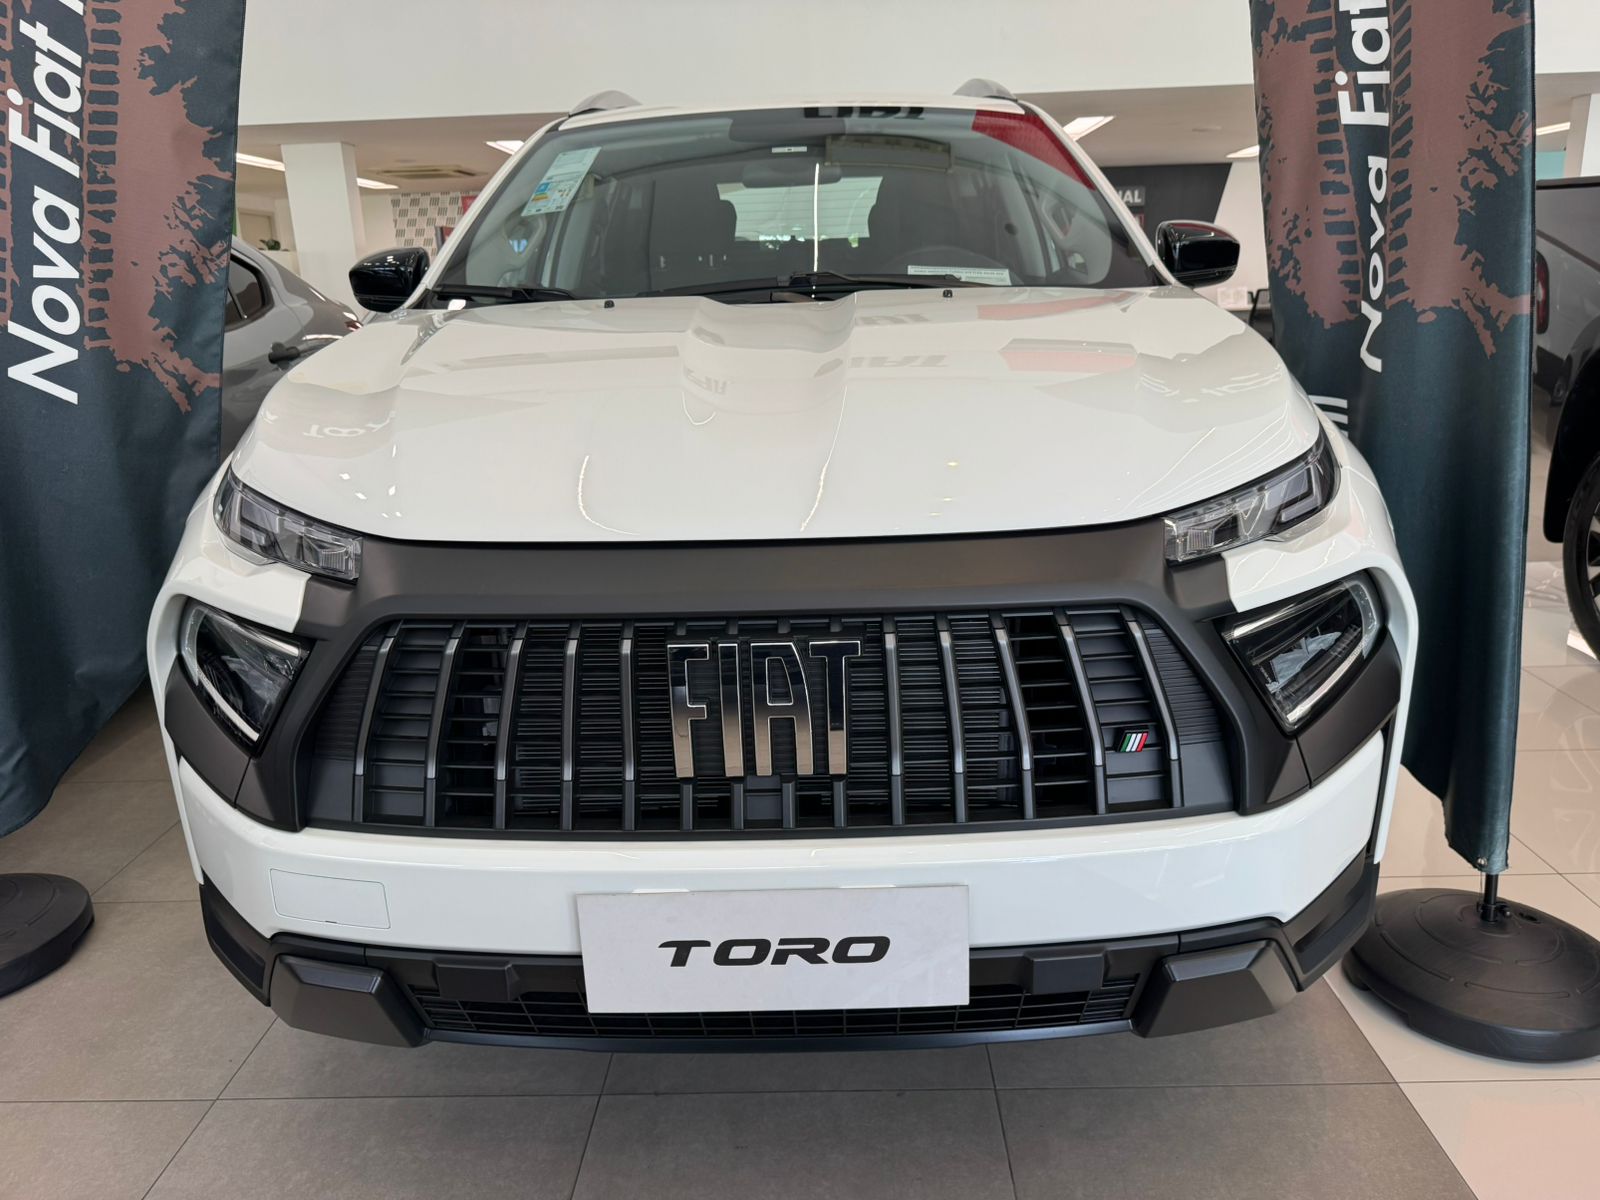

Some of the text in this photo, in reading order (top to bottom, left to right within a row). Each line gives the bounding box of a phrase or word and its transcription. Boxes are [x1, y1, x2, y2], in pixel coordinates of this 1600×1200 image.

[6, 19, 83, 405] Nova Fiat
[1334, 0, 1391, 373] Nova Fiat
[666, 640, 861, 778] FIAT
[658, 935, 891, 968] TORO
